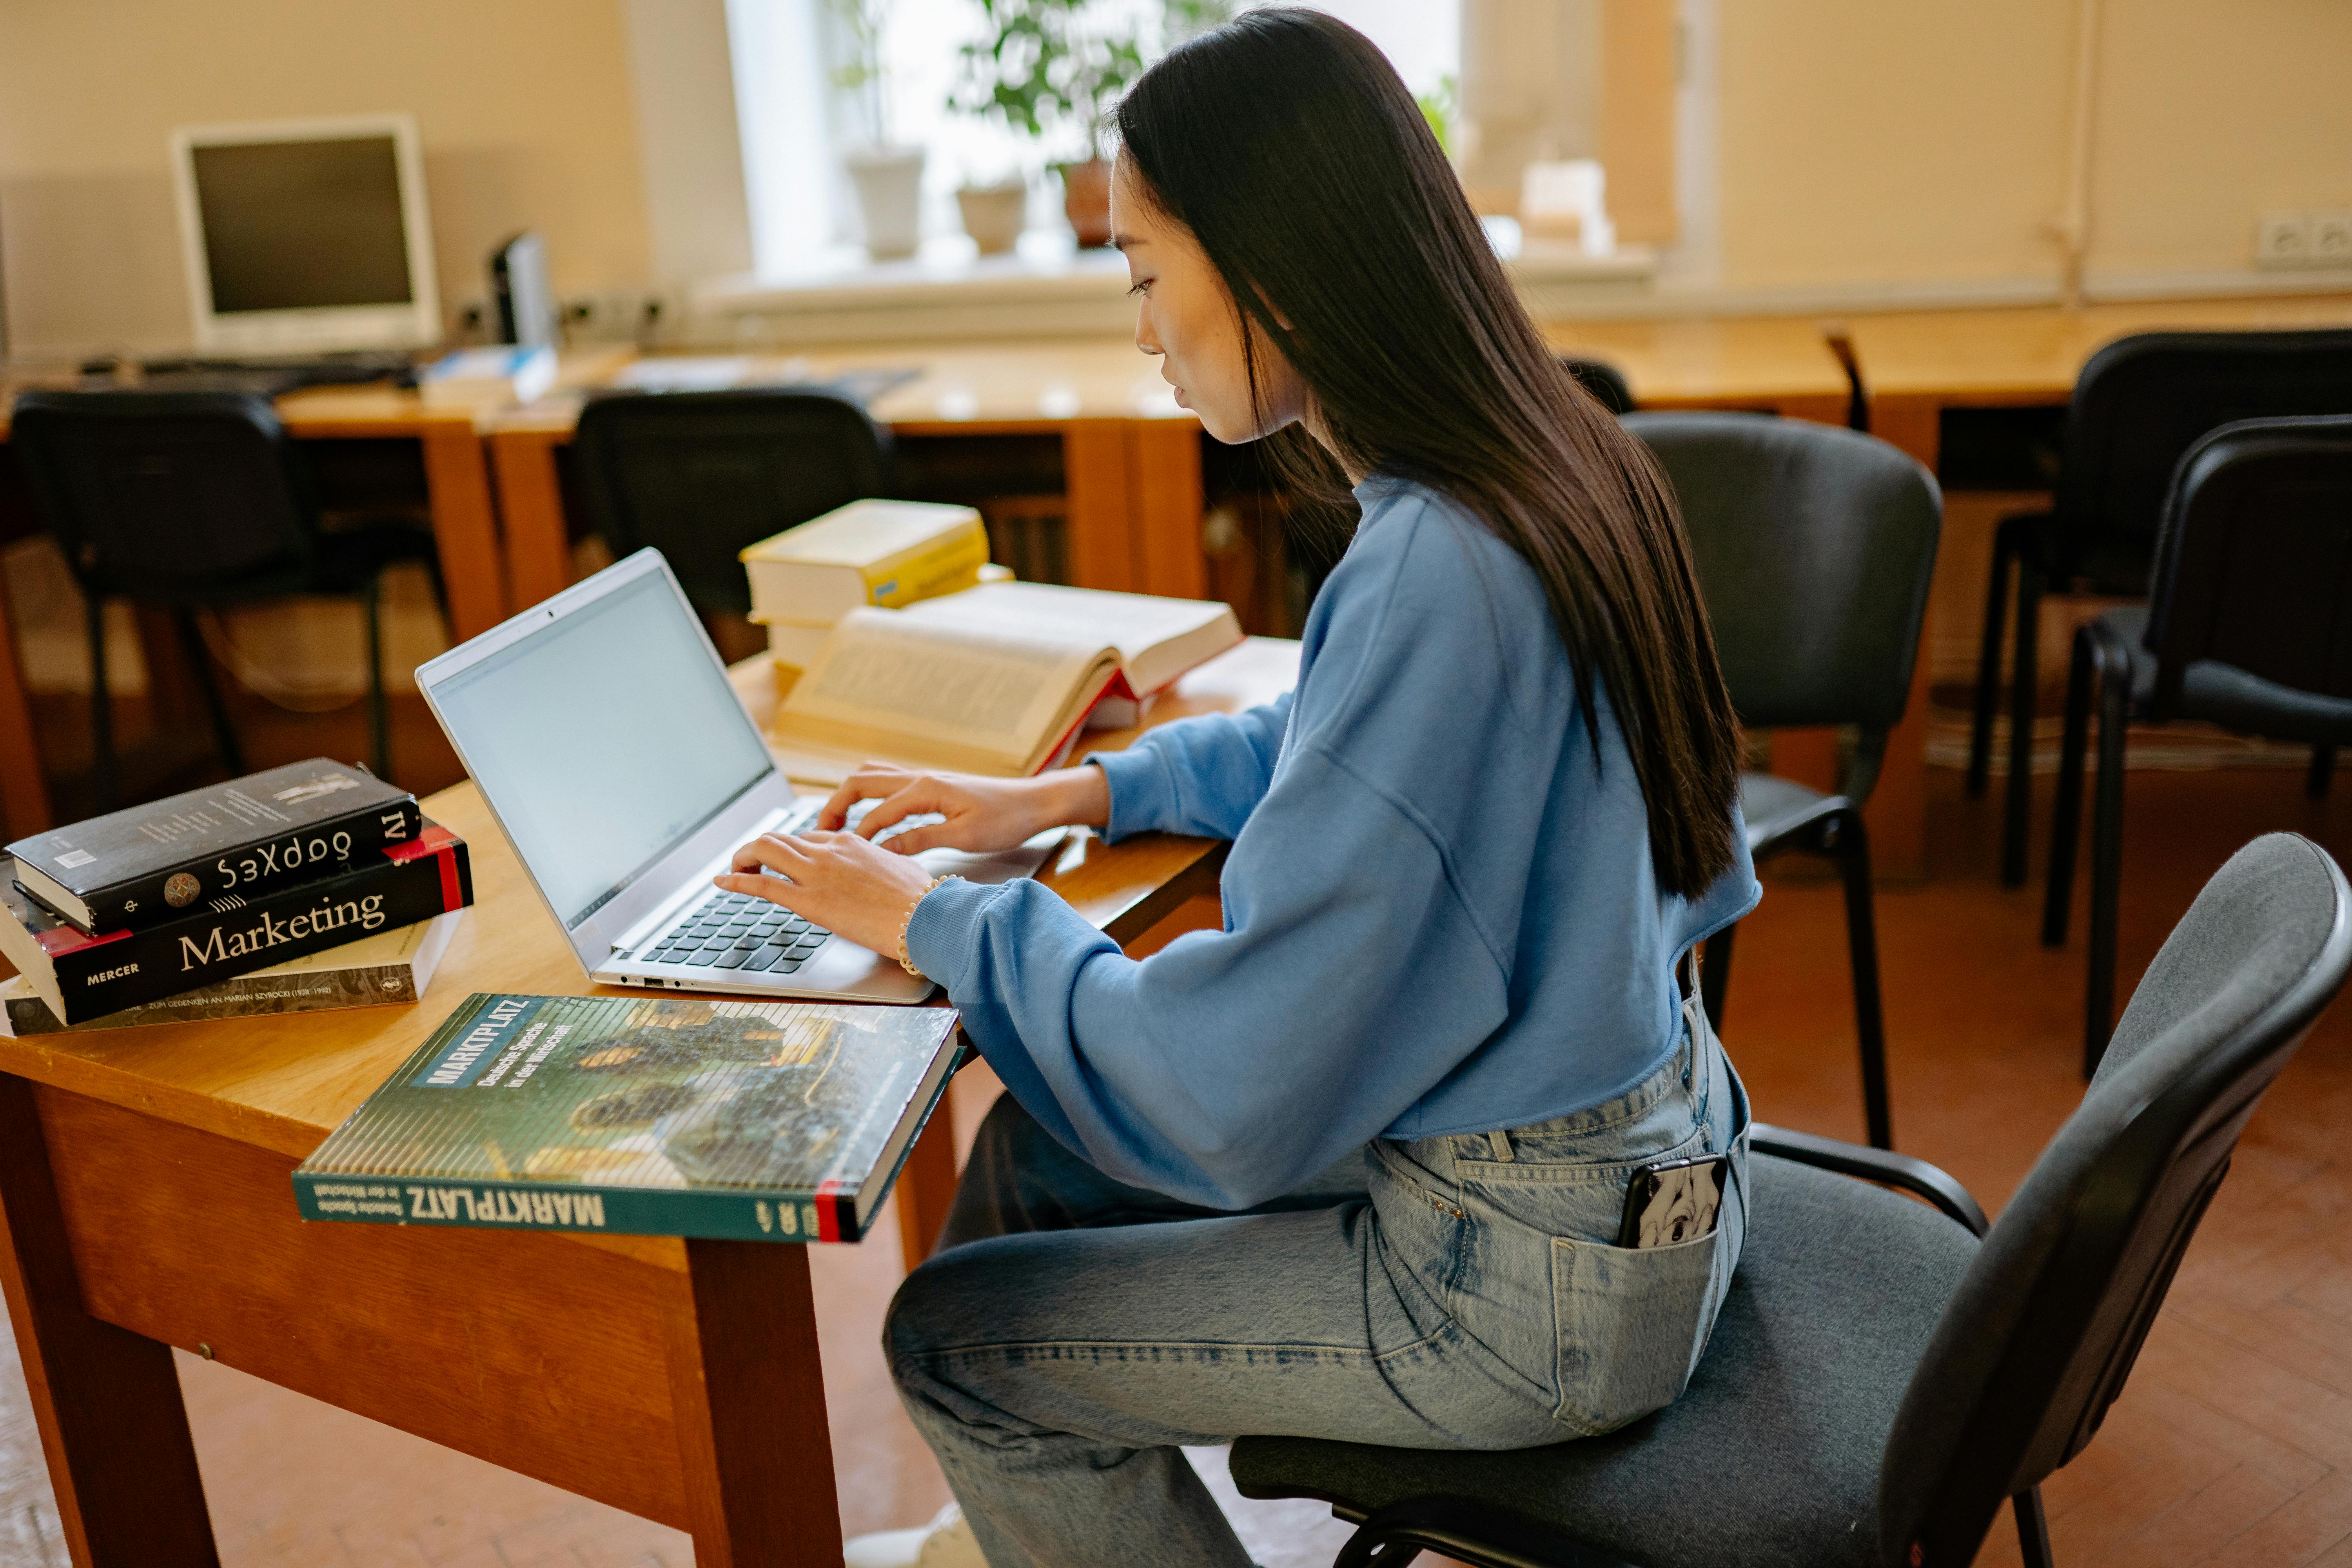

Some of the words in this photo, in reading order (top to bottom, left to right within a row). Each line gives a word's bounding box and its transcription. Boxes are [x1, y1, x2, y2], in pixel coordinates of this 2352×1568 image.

[381, 810, 407, 839] IV
[178, 894, 386, 972] Marketing
[87, 962, 140, 987] MERCER
[168, 998, 209, 1008] GEDENKEN
[224, 994, 253, 1003] MARIAN
[255, 990, 290, 1000] SZYROCKI
[426, 999, 530, 1084] MARKTPLATZ
[476, 1051, 521, 1087] Deutsche
[509, 1022, 549, 1052] Sprache
[525, 1024, 573, 1063] Wirtschaft
[503, 1077, 526, 1088] in
[514, 1063, 539, 1078] der
[406, 1186, 606, 1227] MARKTPLATZ
